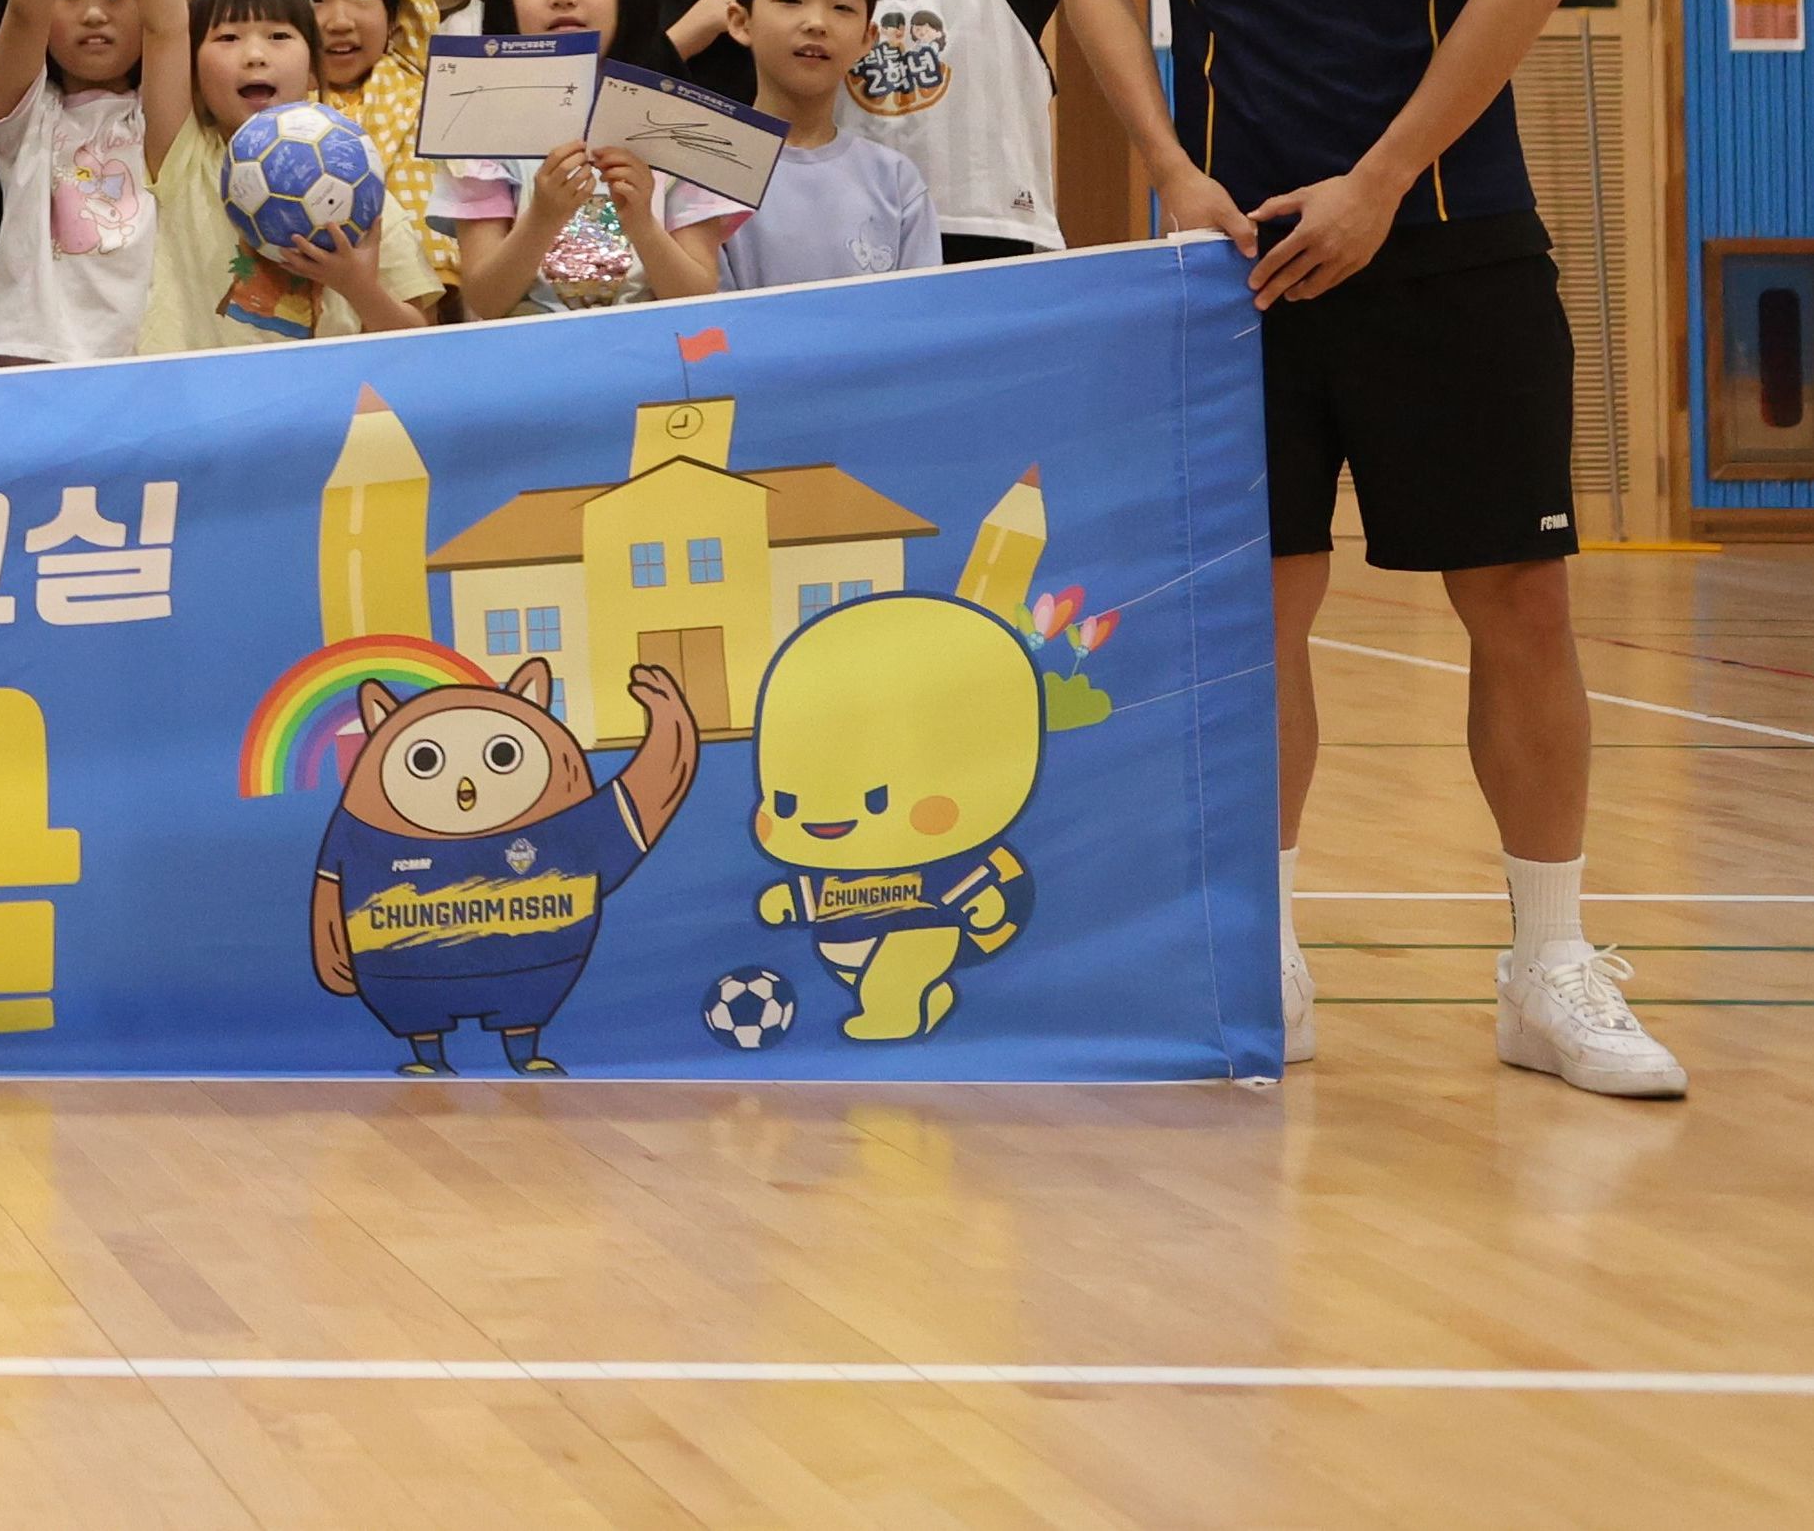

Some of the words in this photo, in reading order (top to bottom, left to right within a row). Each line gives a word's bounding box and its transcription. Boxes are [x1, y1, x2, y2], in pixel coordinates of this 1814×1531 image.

[866, 50, 938, 95] 2학년
[370, 898, 504, 930] CHUNGNAM
[509, 892, 573, 920] ASAN
[823, 884, 917, 907] CHUNGNAM
